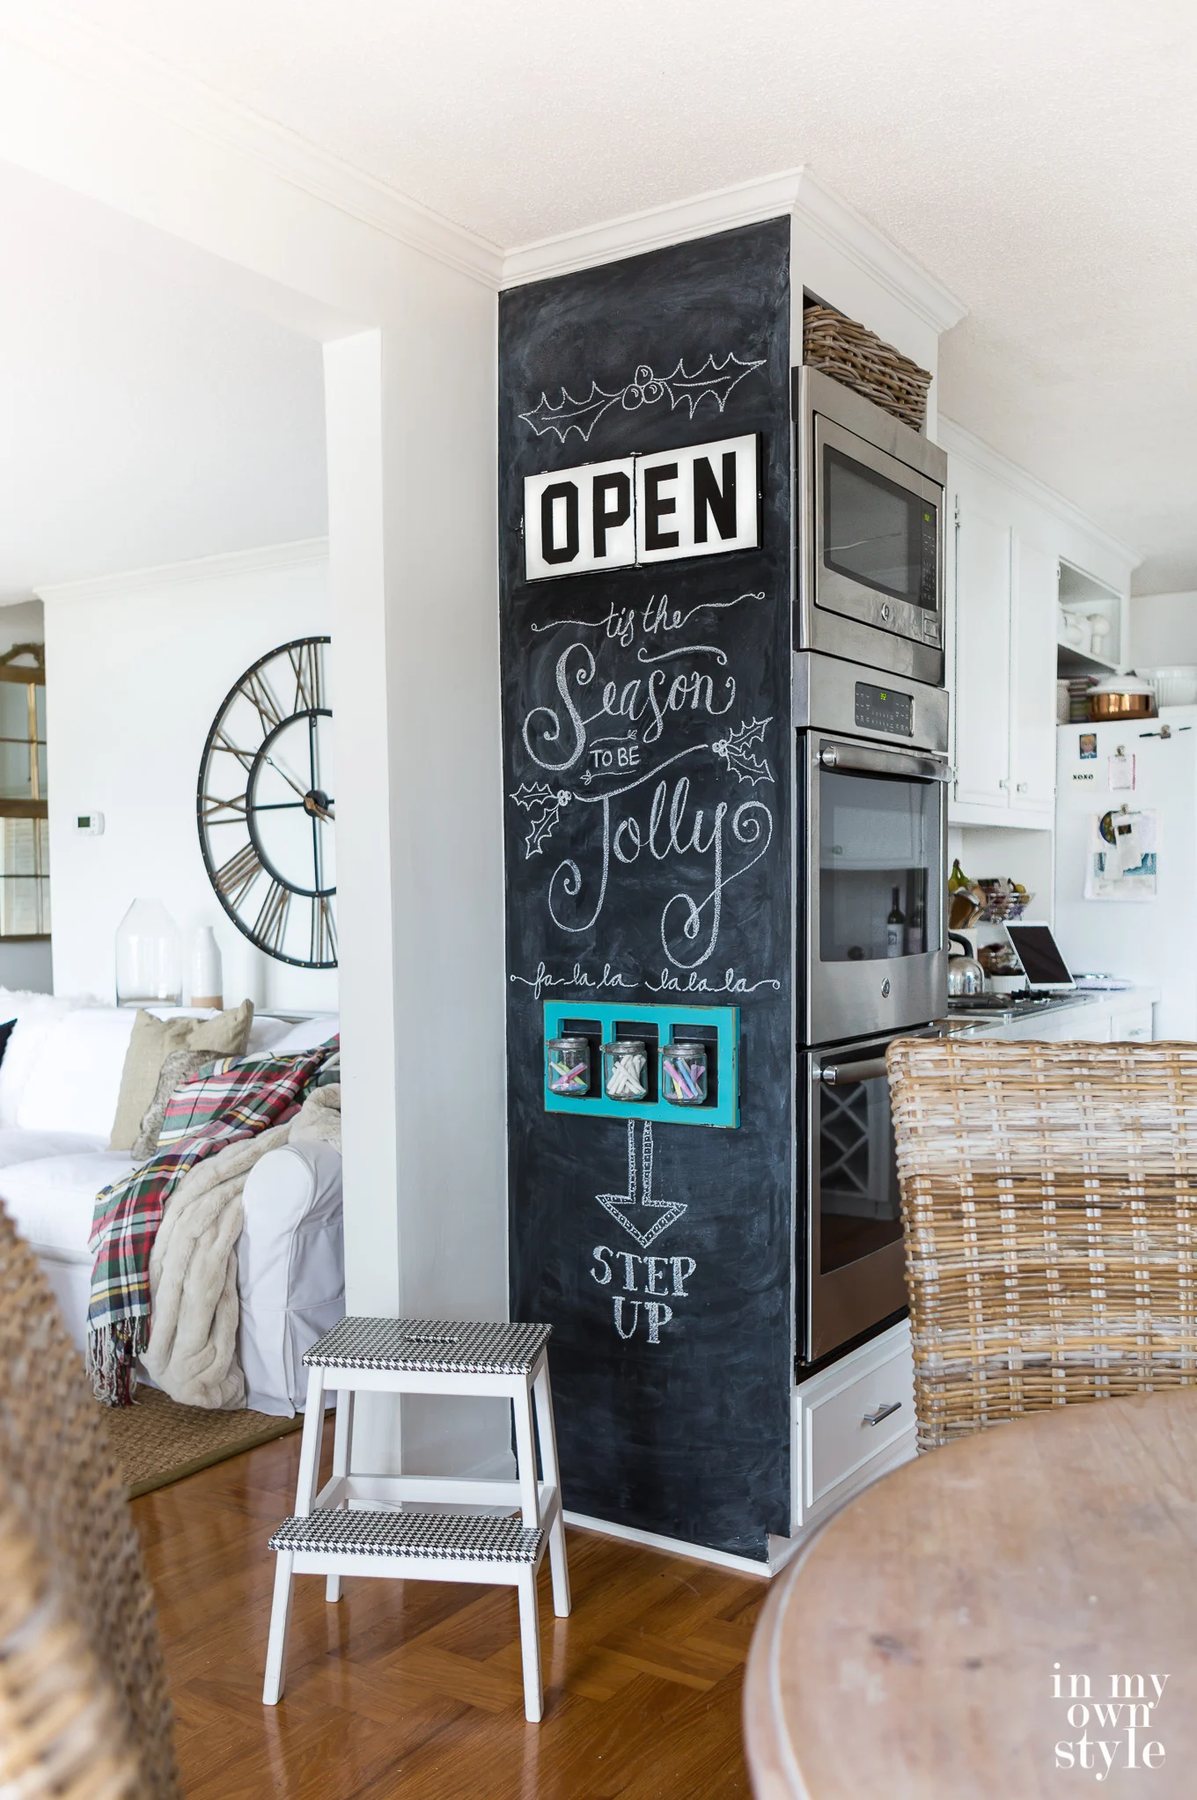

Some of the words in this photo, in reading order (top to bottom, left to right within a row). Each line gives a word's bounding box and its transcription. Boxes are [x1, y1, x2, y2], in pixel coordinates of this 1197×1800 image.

[541, 451, 737, 565] OPEN
[641, 594, 682, 634] the
[522, 643, 736, 771] Season
[589, 749, 613, 768] TO
[617, 745, 640, 767] BE
[548, 775, 773, 968] Jolly
[532, 961, 565, 999] fa
[564, 962, 596, 987] la
[597, 963, 638, 989] la
[656, 967, 682, 992] la
[682, 971, 714, 992] la
[718, 967, 756, 992] la
[590, 1245, 697, 1297] STEP
[612, 1296, 673, 1344] UP
